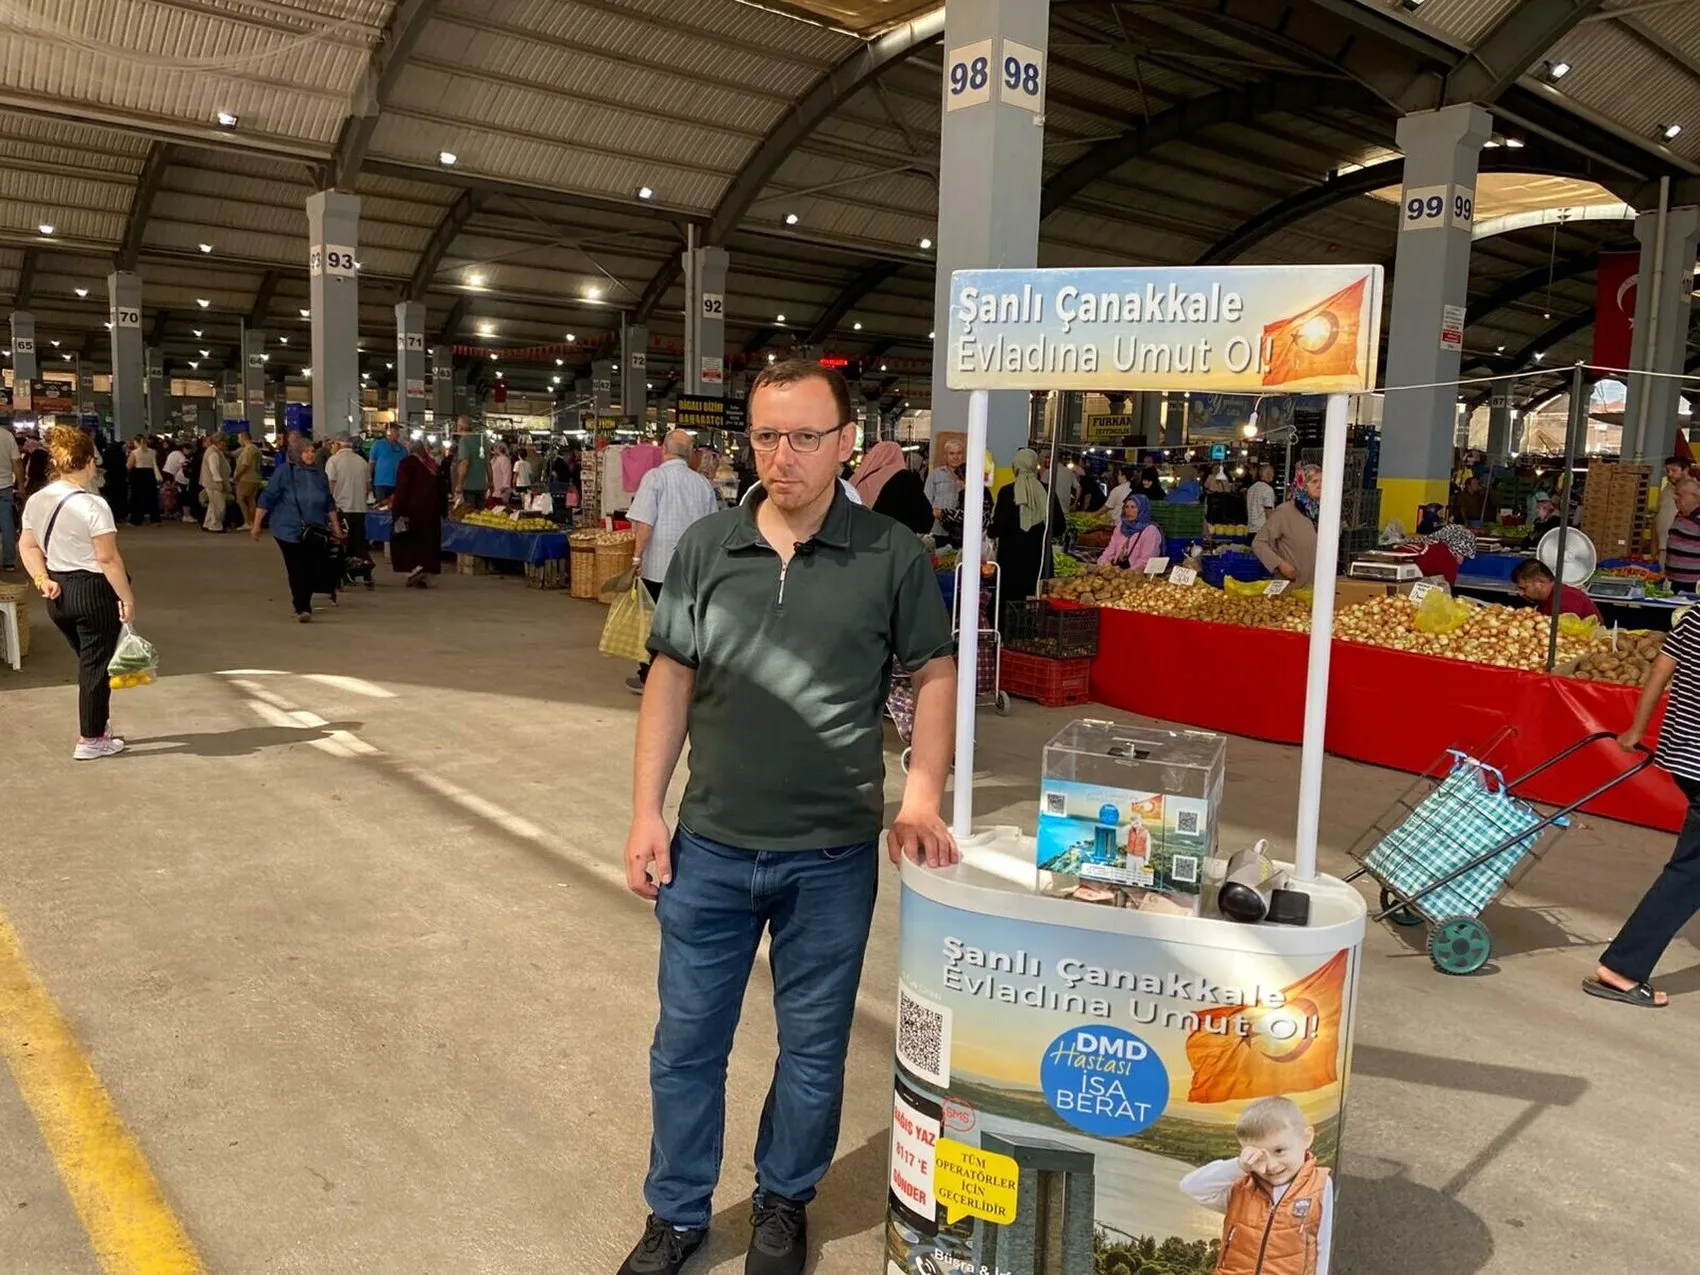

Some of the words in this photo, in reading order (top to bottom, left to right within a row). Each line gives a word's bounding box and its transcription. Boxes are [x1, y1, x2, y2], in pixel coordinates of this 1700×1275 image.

[951, 57, 988, 95] 98
[1004, 56, 1039, 96] 98
[1407, 196, 1444, 220] 99
[1454, 195, 1472, 220] 99
[328, 252, 353, 269] 93
[119, 312, 138, 323] 70
[704, 299, 722, 313] 92
[957, 283, 1043, 332] Şanlı
[1056, 283, 1244, 333] Çanakkale
[17, 341, 33, 350] 65
[408, 337, 422, 347] 71
[957, 333, 1099, 374] Evladına
[1113, 335, 1213, 374] Umut
[1225, 335, 1273, 374] Ol!
[250, 356, 262, 365] 64
[632, 356, 645, 366] 72
[943, 935, 1041, 978] Şanlı
[1056, 957, 1287, 1009] Çanakkale
[943, 963, 1112, 1018] Evladına
[1128, 997, 1251, 1037] Umut
[1268, 1015, 1320, 1041] Ol!
[1049, 1040, 1132, 1077] Hastası
[1076, 1032, 1148, 1061] DMD
[1081, 1069, 1127, 1101] İSA
[946, 1107, 969, 1124] SMS
[1056, 1088, 1152, 1122] BERAT
[915, 1125, 936, 1148] YAZ
[961, 1151, 986, 1169] TÜM
[935, 1157, 1016, 1191] OPERATÖRLER
[961, 1179, 985, 1197] İÇİN
[938, 1186, 1006, 1217] GEÇERLİDİR
[934, 1247, 975, 1274] Büşra
